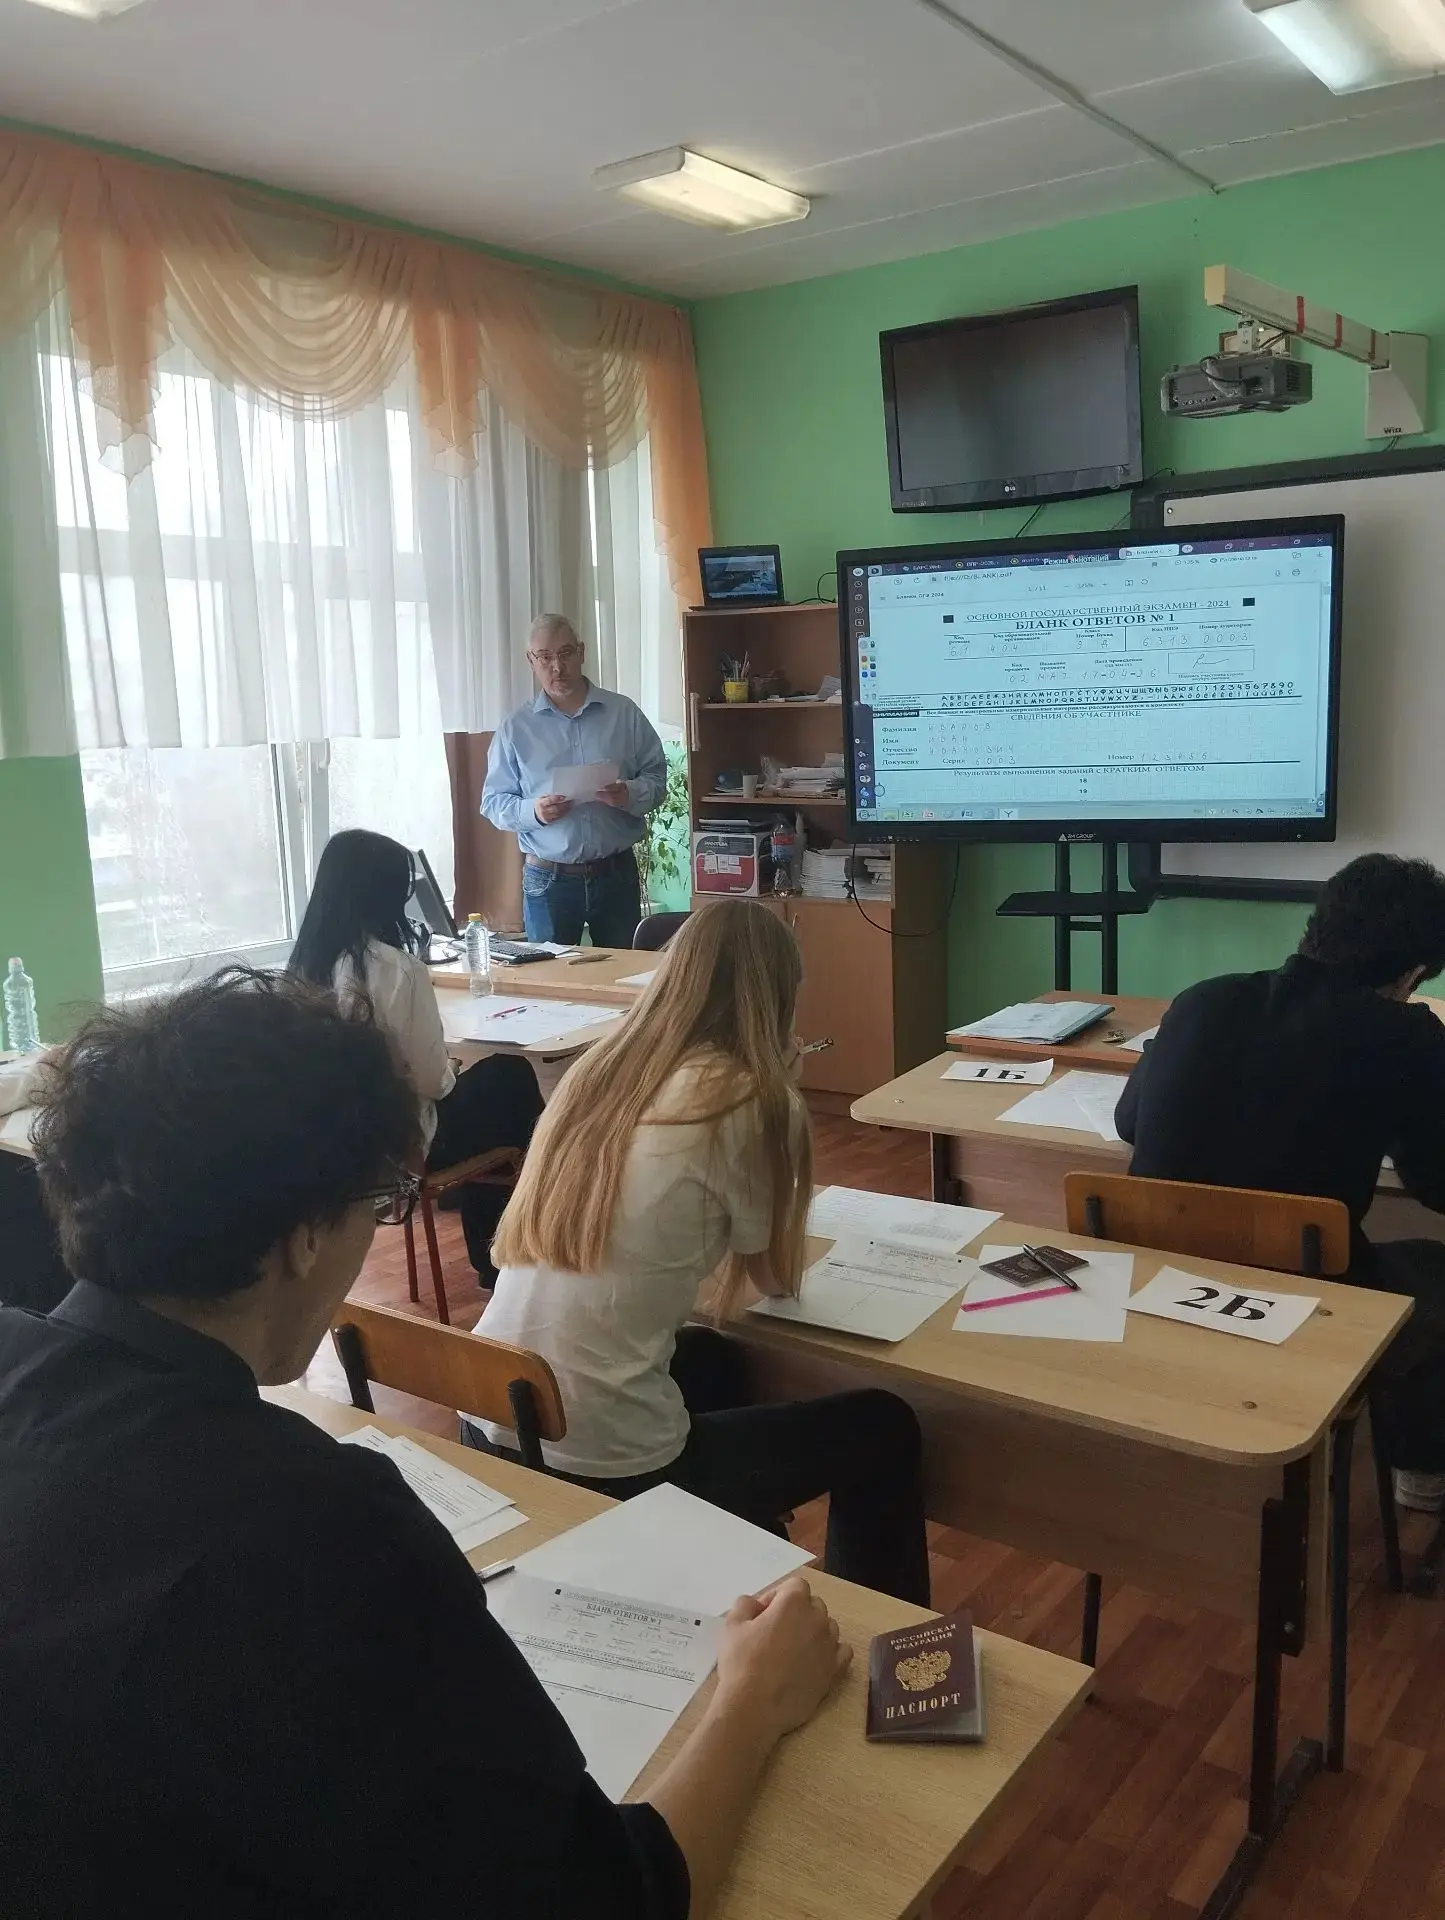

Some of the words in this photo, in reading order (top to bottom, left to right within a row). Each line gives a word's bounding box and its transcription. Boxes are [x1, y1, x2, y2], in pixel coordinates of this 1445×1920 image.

[966, 610, 1027, 621] ОСНОВНОЙ
[1030, 603, 1141, 618] ГОСУДАРСТВЕННЫЙ
[1143, 601, 1197, 611] ЭКЗАМЕН
[1207, 600, 1230, 608] 2024
[1016, 618, 1068, 630] БЛАНК
[1072, 614, 1146, 627] ОТВЕТОВ
[1150, 613, 1164, 622] №
[1169, 613, 1175, 622] 1
[1010, 712, 1061, 721] СВЕДЕНИЯ
[1080, 710, 1142, 719] УЧАСТНИКЕ
[954, 770, 1001, 778] Результаты
[1058, 767, 1094, 775] заданий
[1103, 766, 1151, 774] КРАТКИМ
[1155, 765, 1206, 773] ОТВЕТОМ
[972, 1068, 1027, 1080] 1Б
[1173, 1286, 1276, 1321] 2Б
[586, 1603, 612, 1615] БЛАНК
[613, 1609, 648, 1623] ОТВЕТОВ
[890, 1623, 957, 1646] РОССИЙСКАЯ
[894, 1631, 954, 1651] ФЕДЕРАЦИЯ
[885, 1691, 961, 1719] ПАСПОРТ
